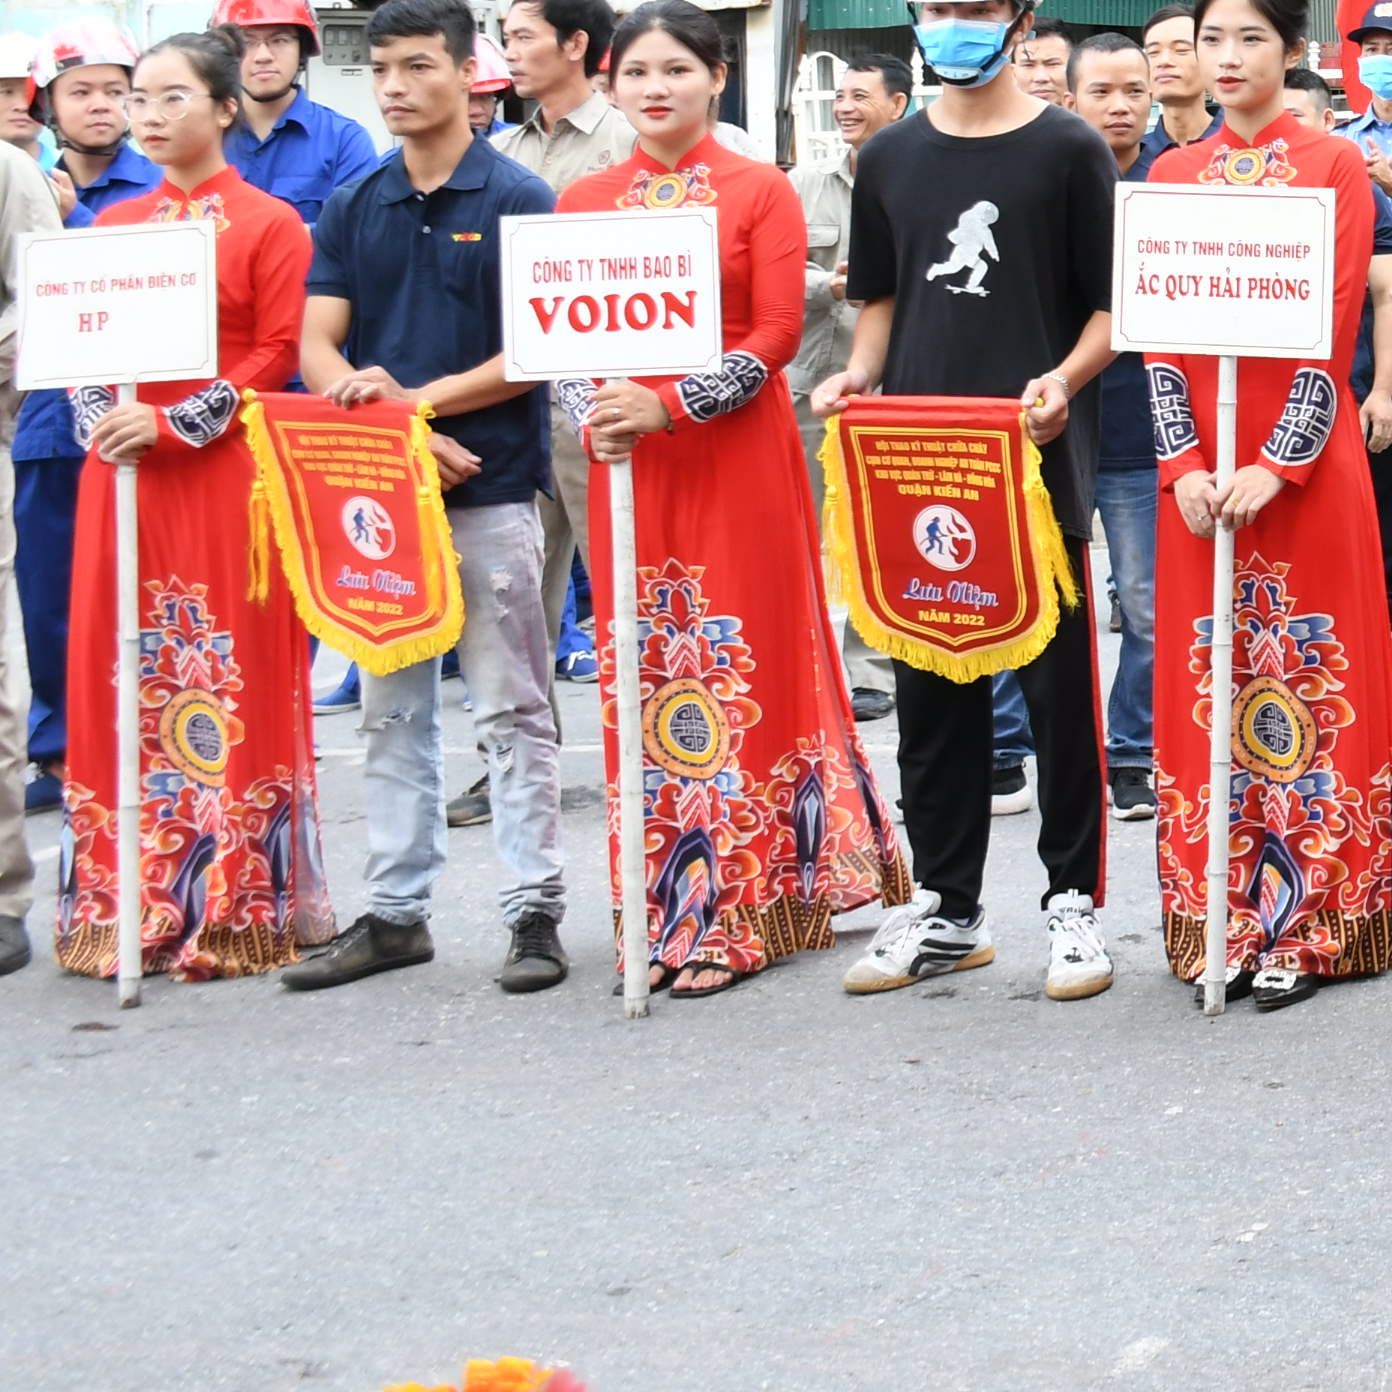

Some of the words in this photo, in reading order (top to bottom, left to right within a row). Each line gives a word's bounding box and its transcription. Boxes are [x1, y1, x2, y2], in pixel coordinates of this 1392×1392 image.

[1138, 236, 1170, 254] CÔNG
[1175, 241, 1187, 255] TY
[1192, 241, 1223, 256] TNHH
[1228, 240, 1261, 257] CÔNG
[1265, 241, 1310, 262] NGHIỆP
[533, 256, 572, 283] CÔNG
[578, 259, 593, 281] TY
[600, 257, 637, 280] TNHH
[643, 255, 671, 278] BAO
[1135, 262, 1159, 295] ẮC
[1165, 274, 1203, 301] QUY
[1209, 267, 1241, 298] HẢI
[1247, 271, 1310, 301] PHÒNG
[36, 279, 68, 297] CÔNG
[73, 281, 86, 294] TY
[529, 291, 698, 334] VOION
[918, 608, 950, 623] NĂM
[953, 613, 985, 626] 2022
